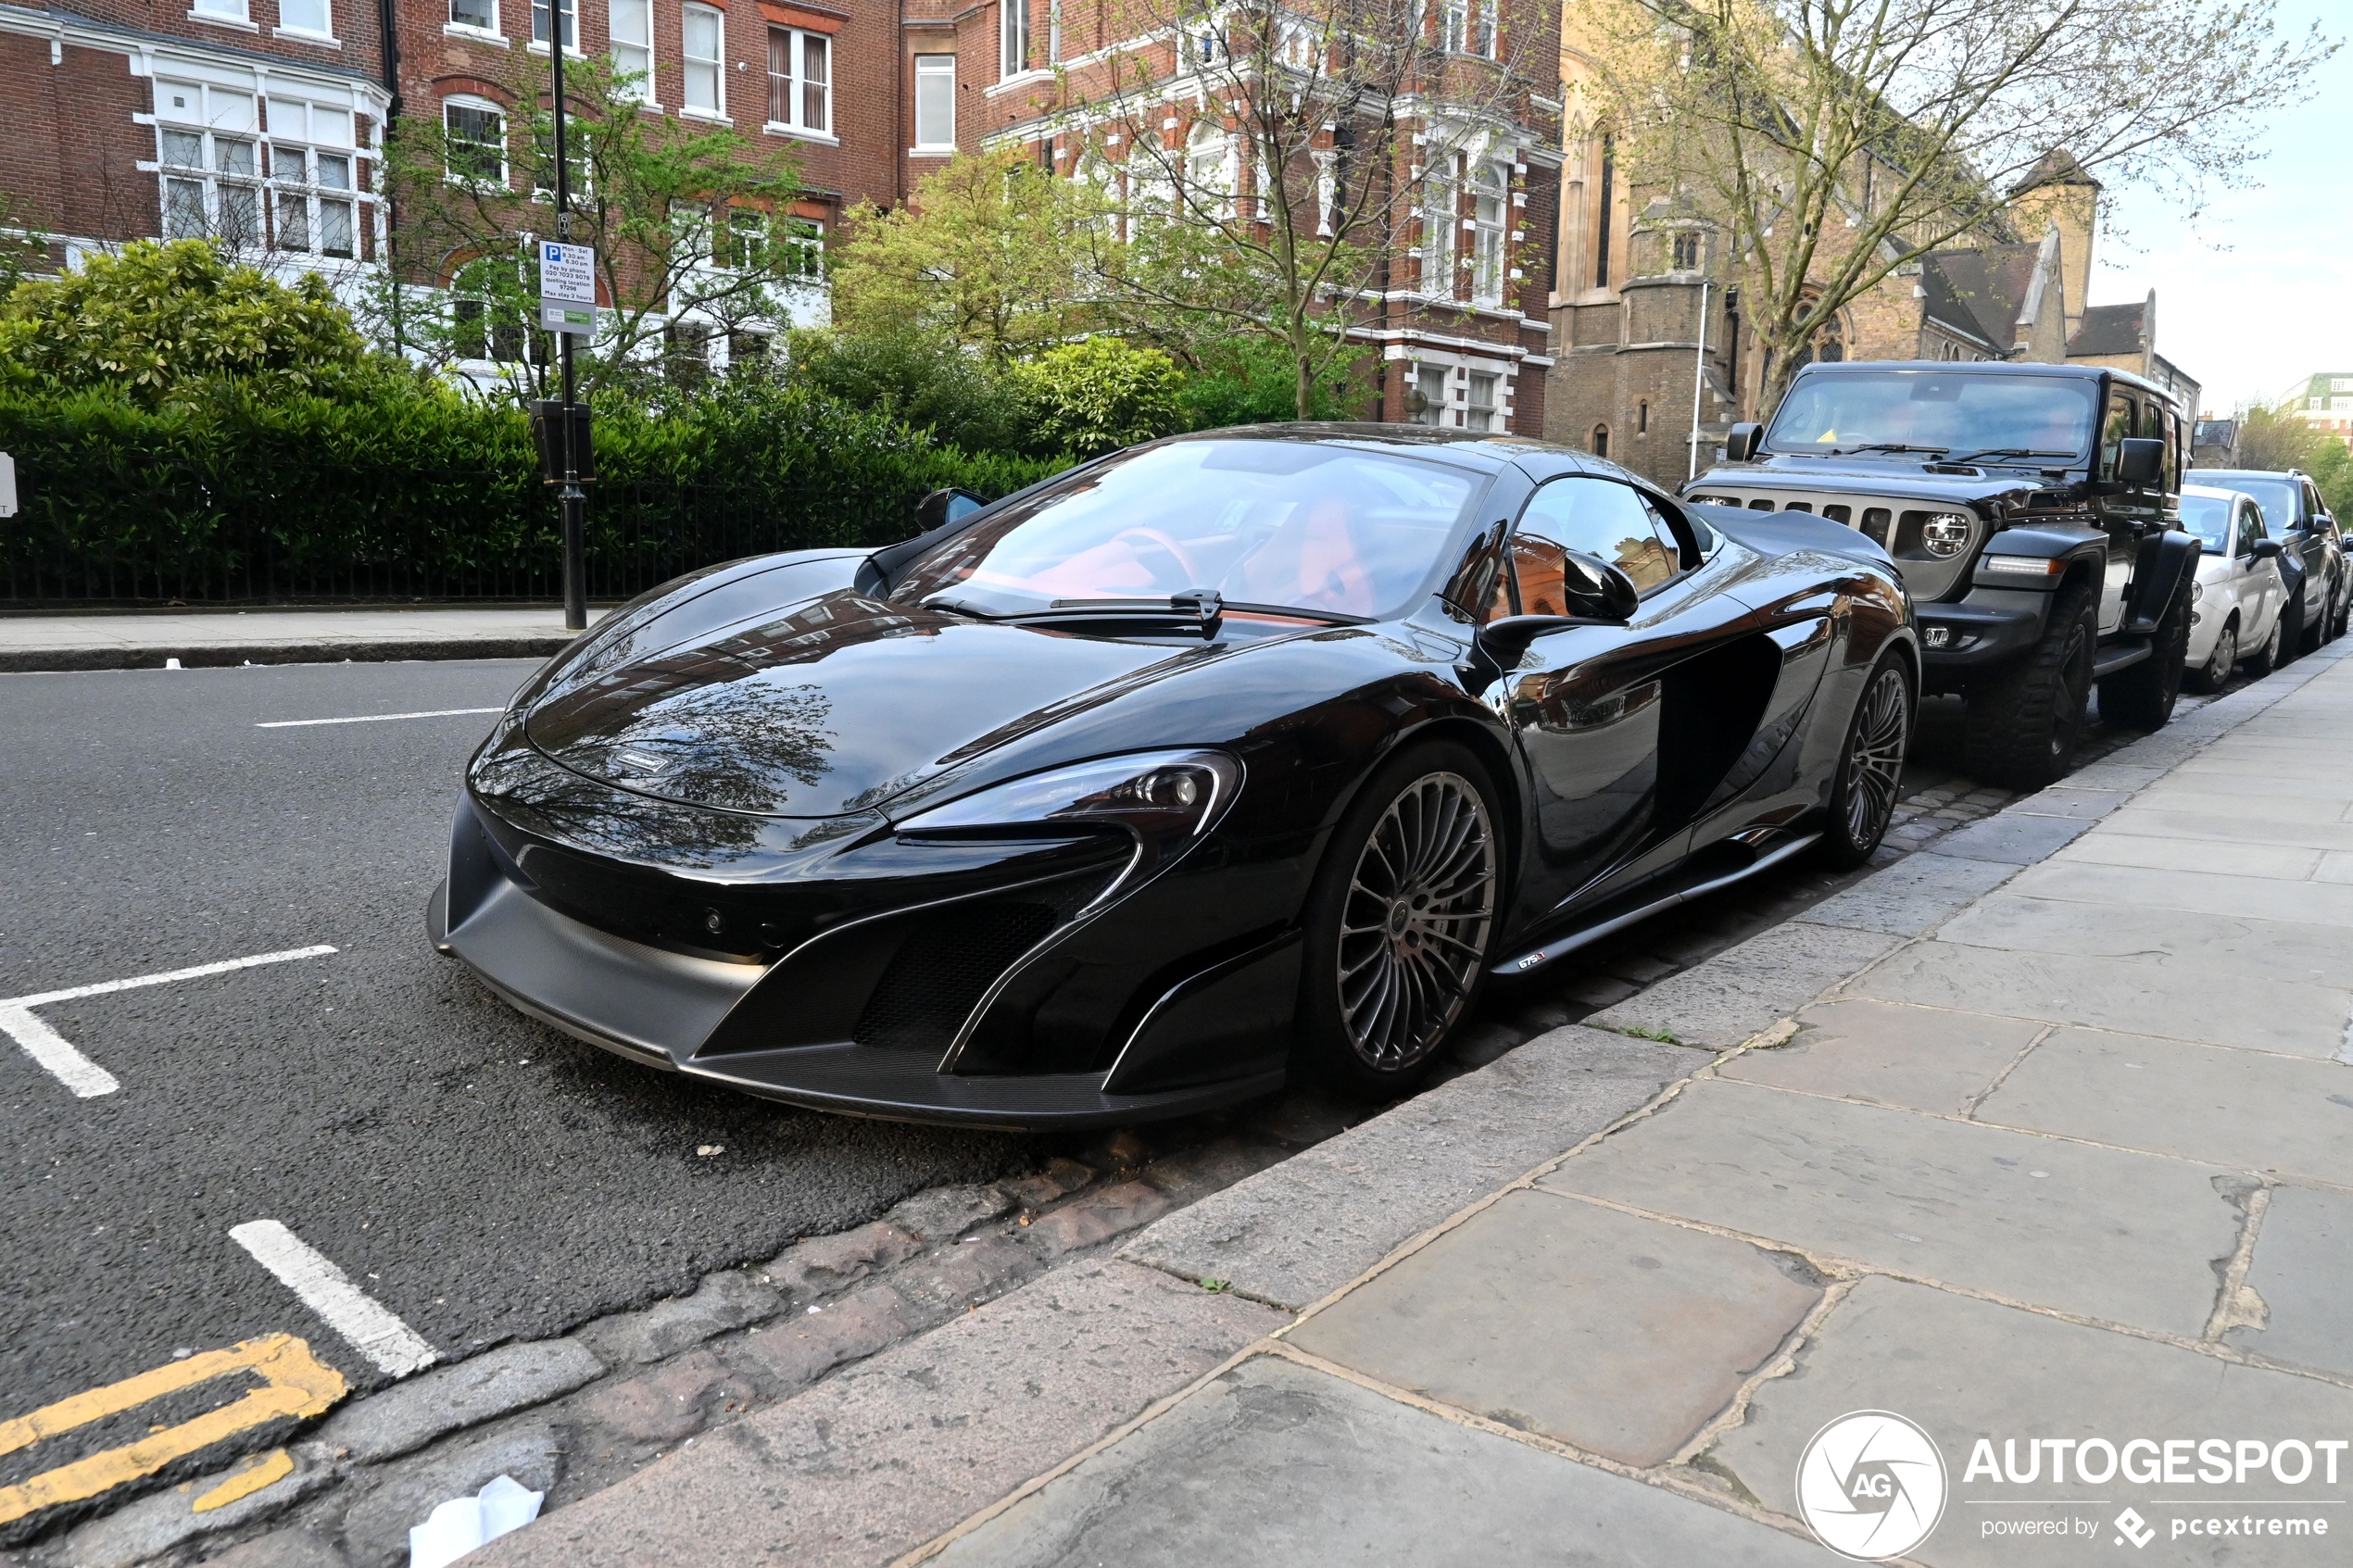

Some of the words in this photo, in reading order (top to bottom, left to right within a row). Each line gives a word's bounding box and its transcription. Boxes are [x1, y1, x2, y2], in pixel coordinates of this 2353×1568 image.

[548, 246, 560, 259] P
[545, 277, 567, 285] quoting
[1518, 950, 1545, 970] 675LT
